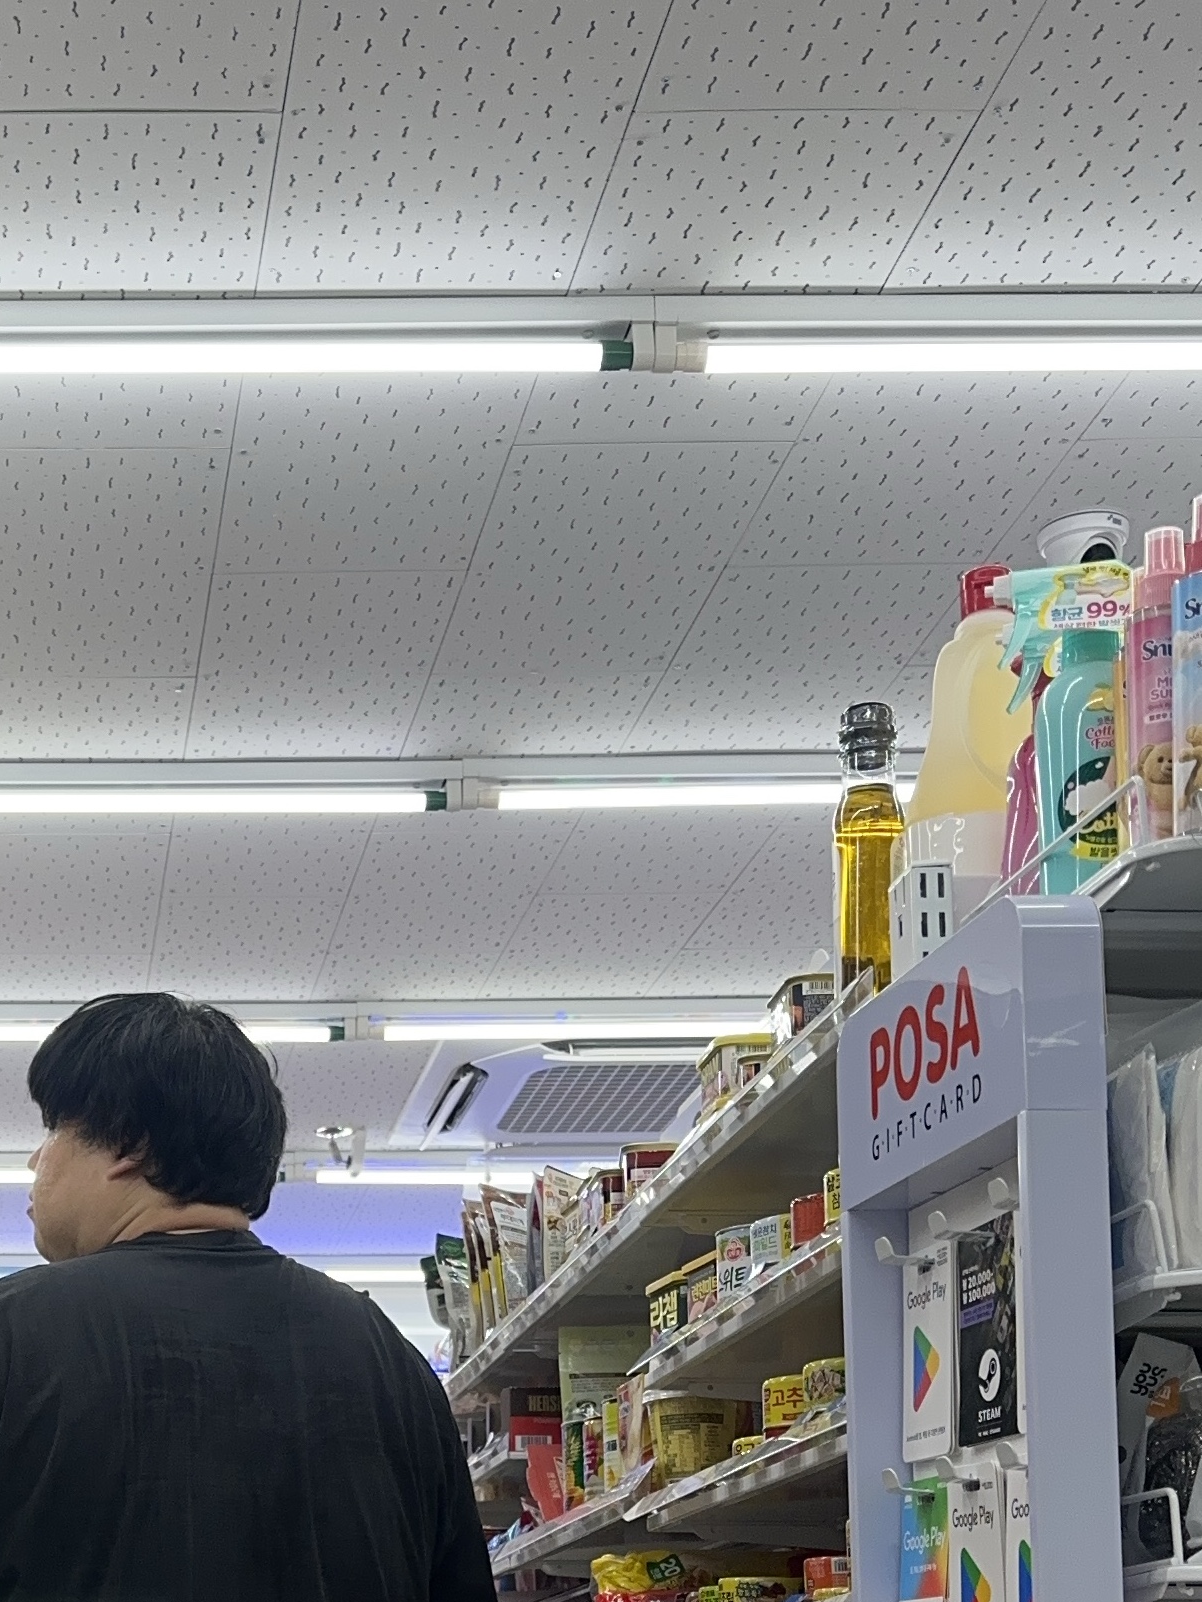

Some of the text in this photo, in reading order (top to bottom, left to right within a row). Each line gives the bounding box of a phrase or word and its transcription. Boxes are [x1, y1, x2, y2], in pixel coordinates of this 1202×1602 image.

[870, 965, 981, 1120] POSA
[650, 1289, 679, 1329] 리챔
[907, 1281, 947, 1310] Google Play
[978, 1406, 1002, 1423] STEAM
[952, 1505, 995, 1532] Google Play
[1011, 1498, 1030, 1519] Goo
[903, 1526, 946, 1555] Google Play
